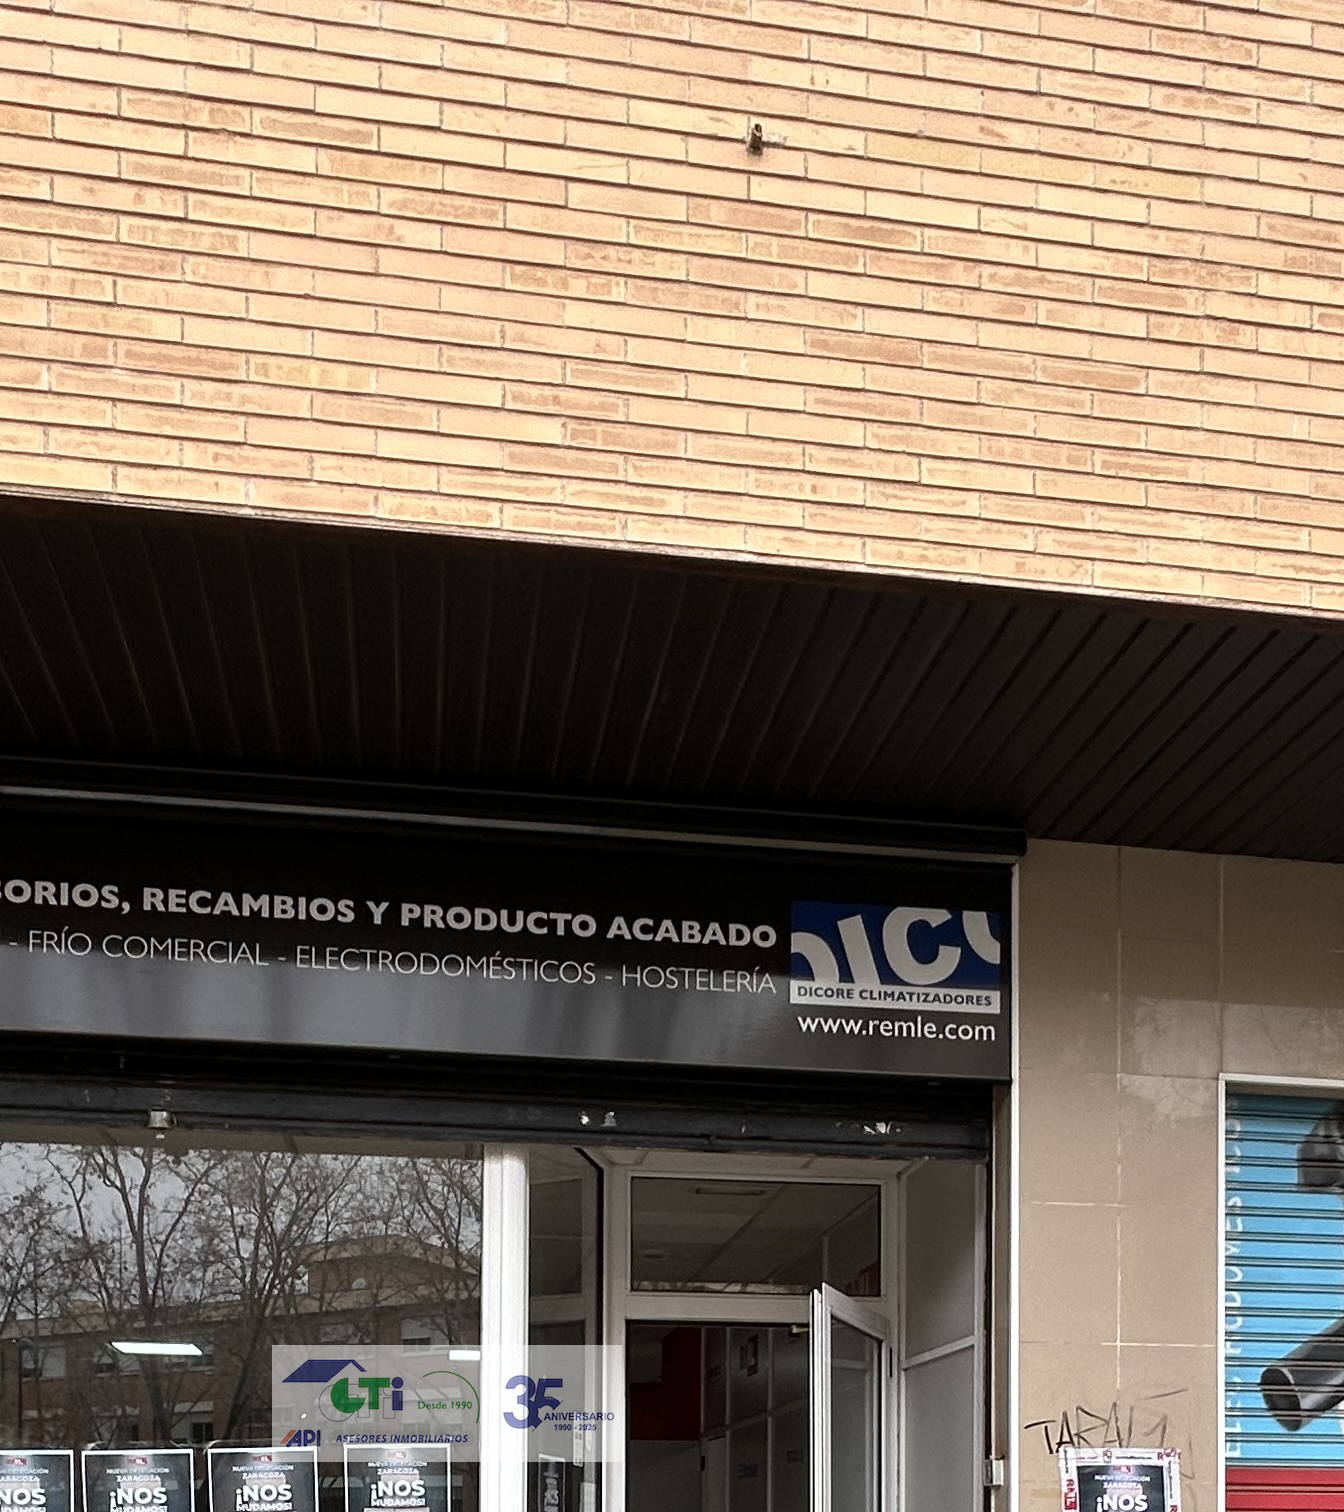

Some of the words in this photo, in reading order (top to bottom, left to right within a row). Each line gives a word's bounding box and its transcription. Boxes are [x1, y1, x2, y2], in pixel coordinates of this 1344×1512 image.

[143, 886, 355, 924] RECAMBIOS
[366, 901, 387, 925] Y
[401, 903, 597, 937] PRODUCTO
[607, 916, 776, 948] ACABADO
[28, 925, 92, 957] FRÍO
[102, 934, 269, 967] COMERCIAL
[296, 944, 596, 985] ELECTRODOMÉSTICOS
[622, 964, 777, 994] HOSTELERÍA
[797, 986, 855, 1000] DICORE
[859, 989, 992, 1006] CLIMATIZADORES
[797, 1015, 995, 1041] www.remle.com
[110, 1487, 167, 1507] ¡NOS
[236, 1484, 292, 1505] ¡NOS
[371, 1480, 425, 1499] ¡NOS
[236, 1503, 292, 1511] MUDAMOS!
[1097, 1494, 1148, 1512] ¡NOS
